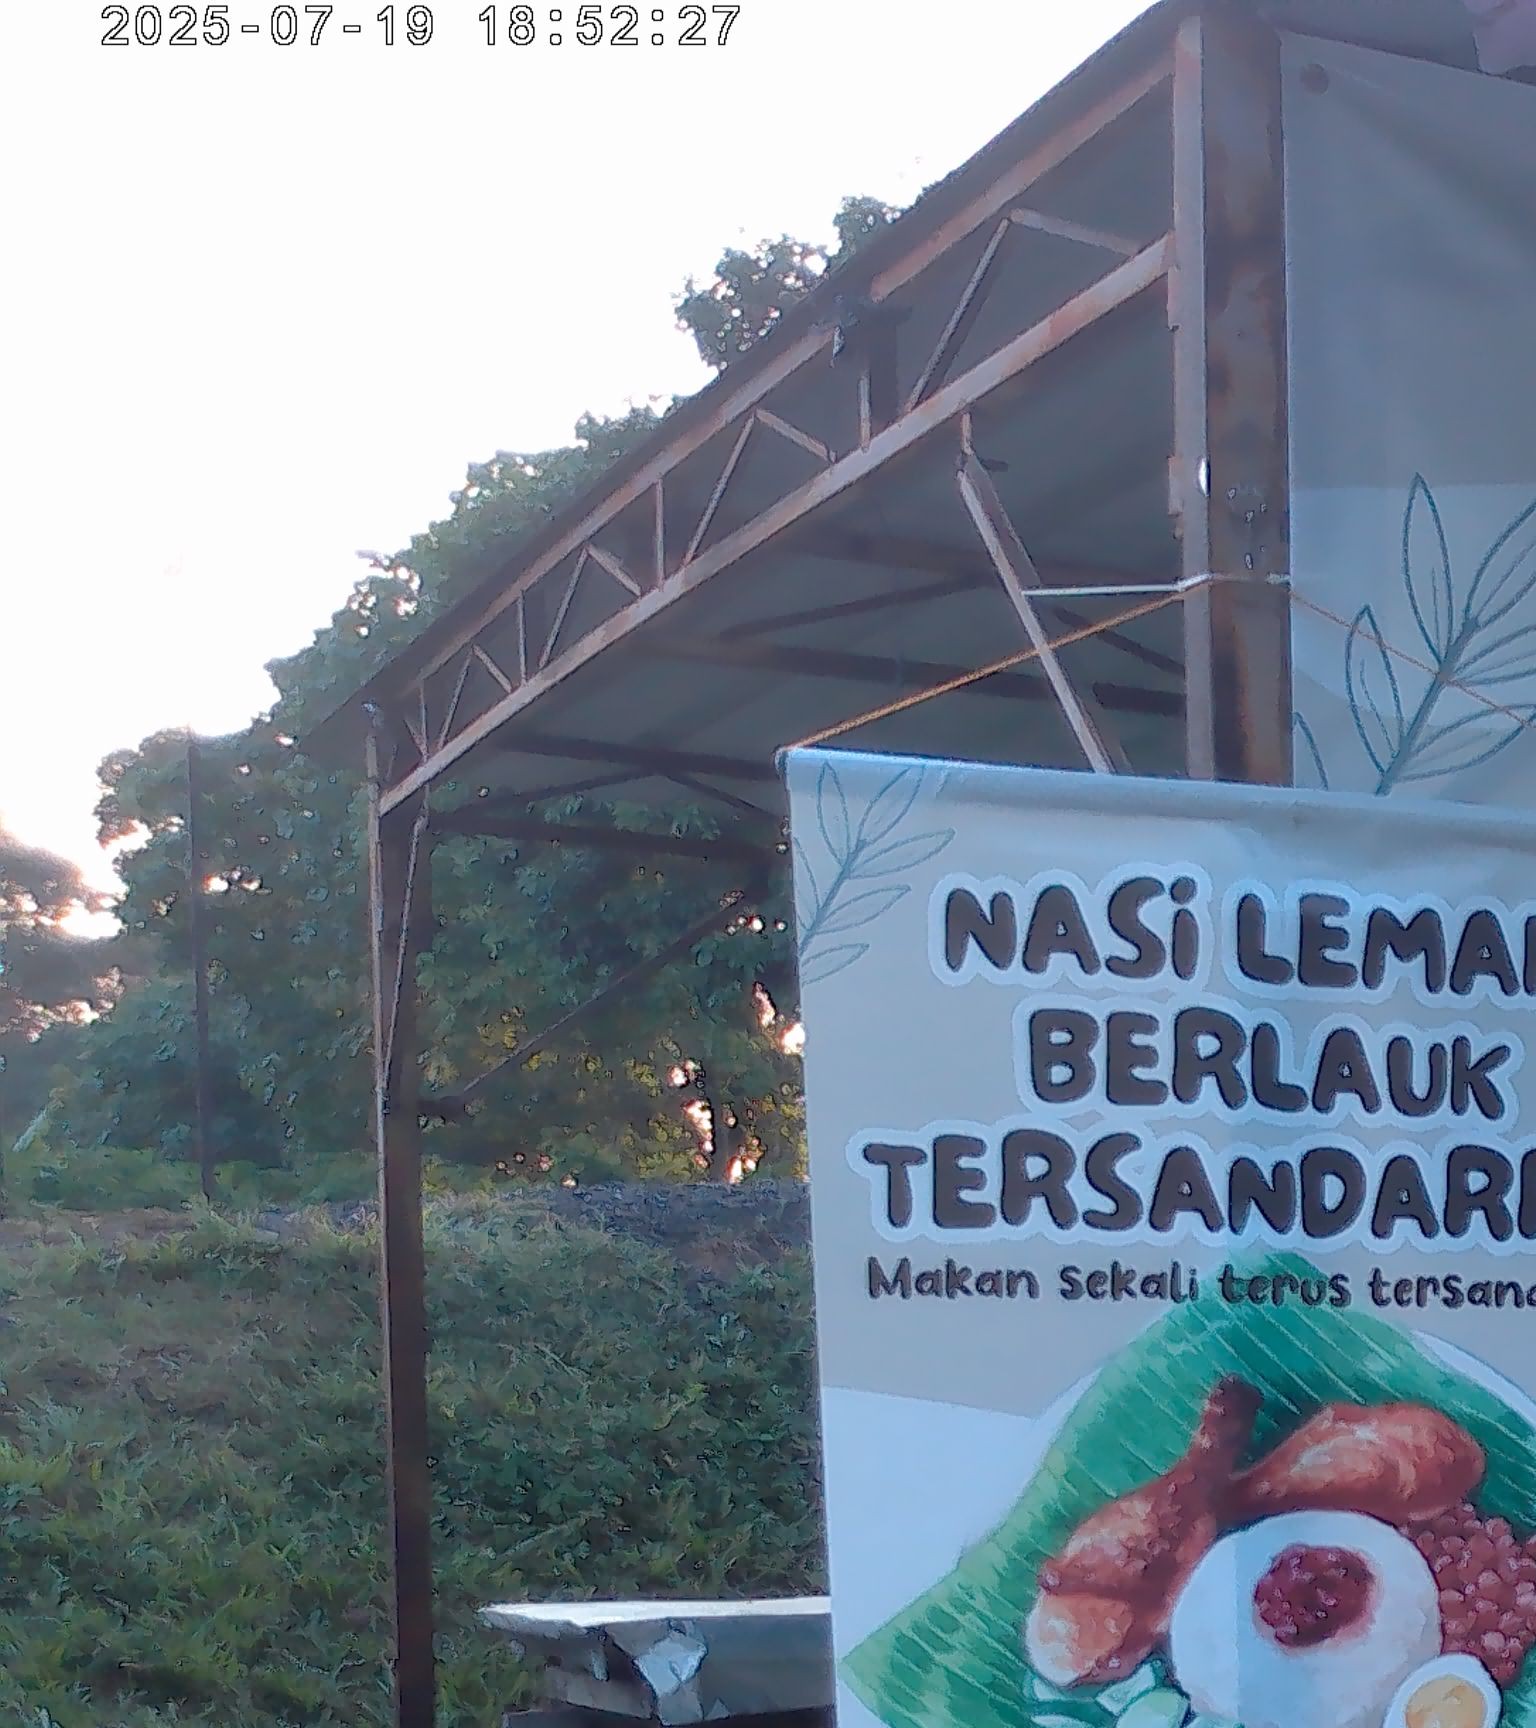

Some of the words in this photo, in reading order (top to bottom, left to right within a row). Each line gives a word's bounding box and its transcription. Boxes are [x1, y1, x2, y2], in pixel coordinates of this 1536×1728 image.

[1027, 1009, 1510, 1120] BERLAUK
[867, 1254, 1039, 1302] Makan
[1218, 1270, 1352, 1308] terus
